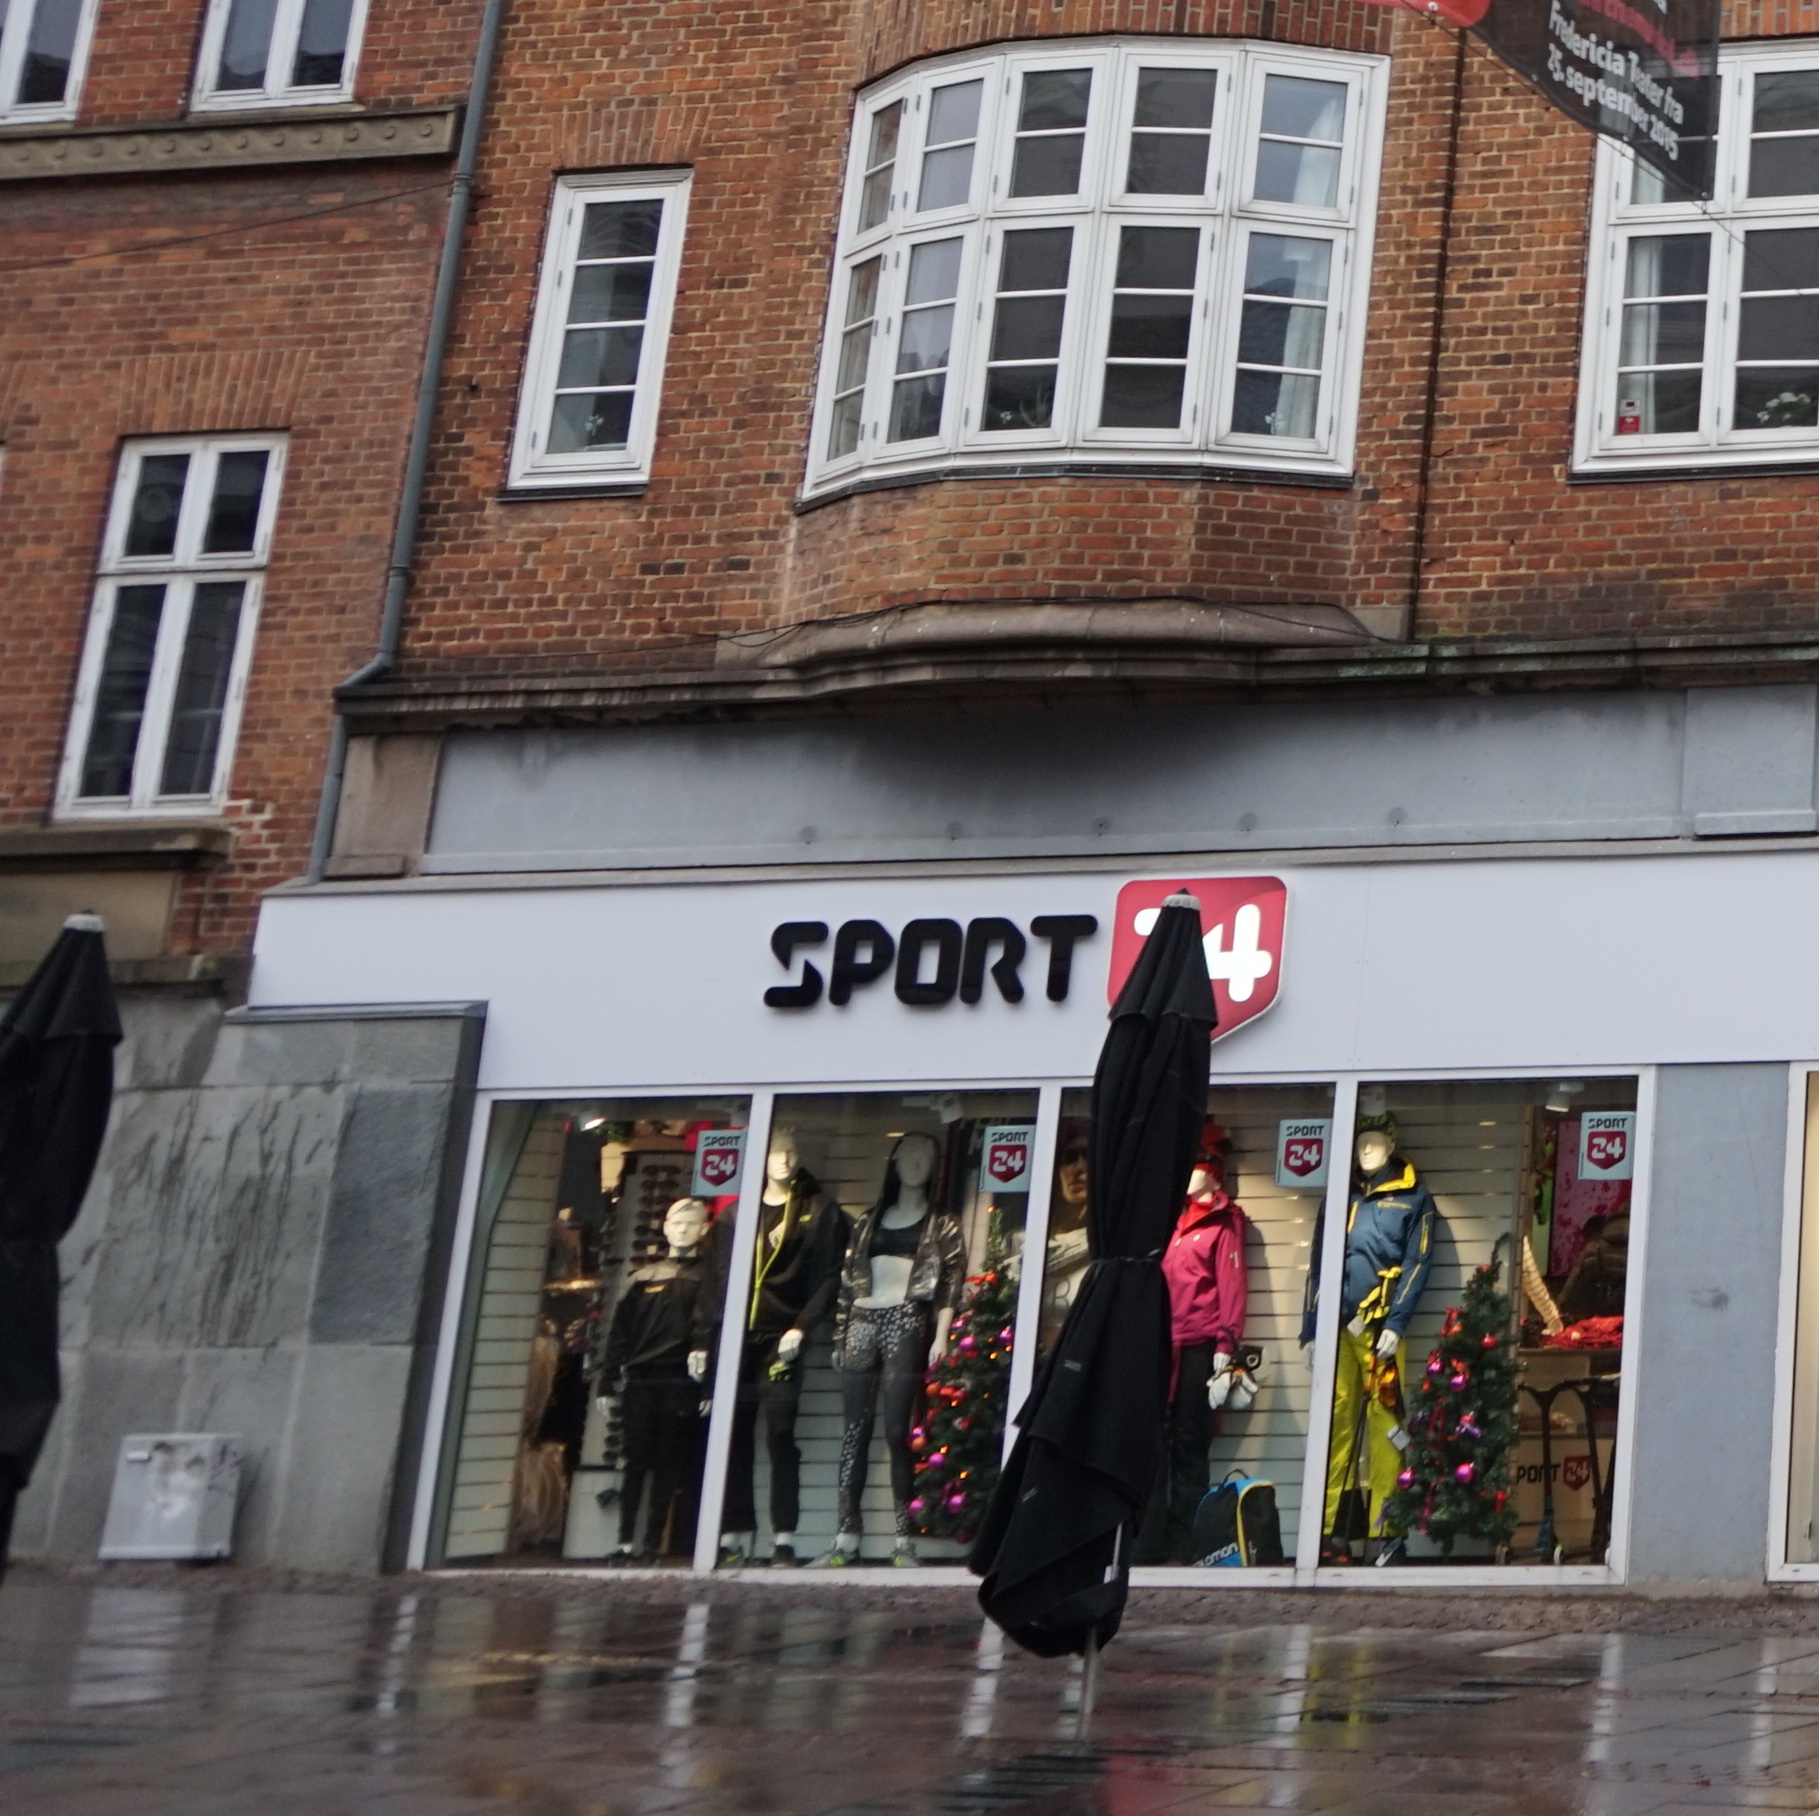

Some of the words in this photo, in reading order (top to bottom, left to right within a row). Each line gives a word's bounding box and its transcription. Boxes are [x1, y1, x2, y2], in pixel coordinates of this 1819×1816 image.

[1565, 64, 1651, 134] september
[1627, 50, 1666, 110] Teater
[1663, 85, 1685, 126] fra
[763, 914, 1099, 1009] SPORT
[1286, 1124, 1325, 1137] SPORT
[1588, 1116, 1628, 1129] SPORT
[703, 1134, 742, 1148] SPORT
[990, 1130, 1029, 1143] SPORT
[1591, 1136, 1623, 1159] 24
[704, 1153, 736, 1177] 24
[992, 1149, 1024, 1172] 24
[1288, 1144, 1320, 1166] 24
